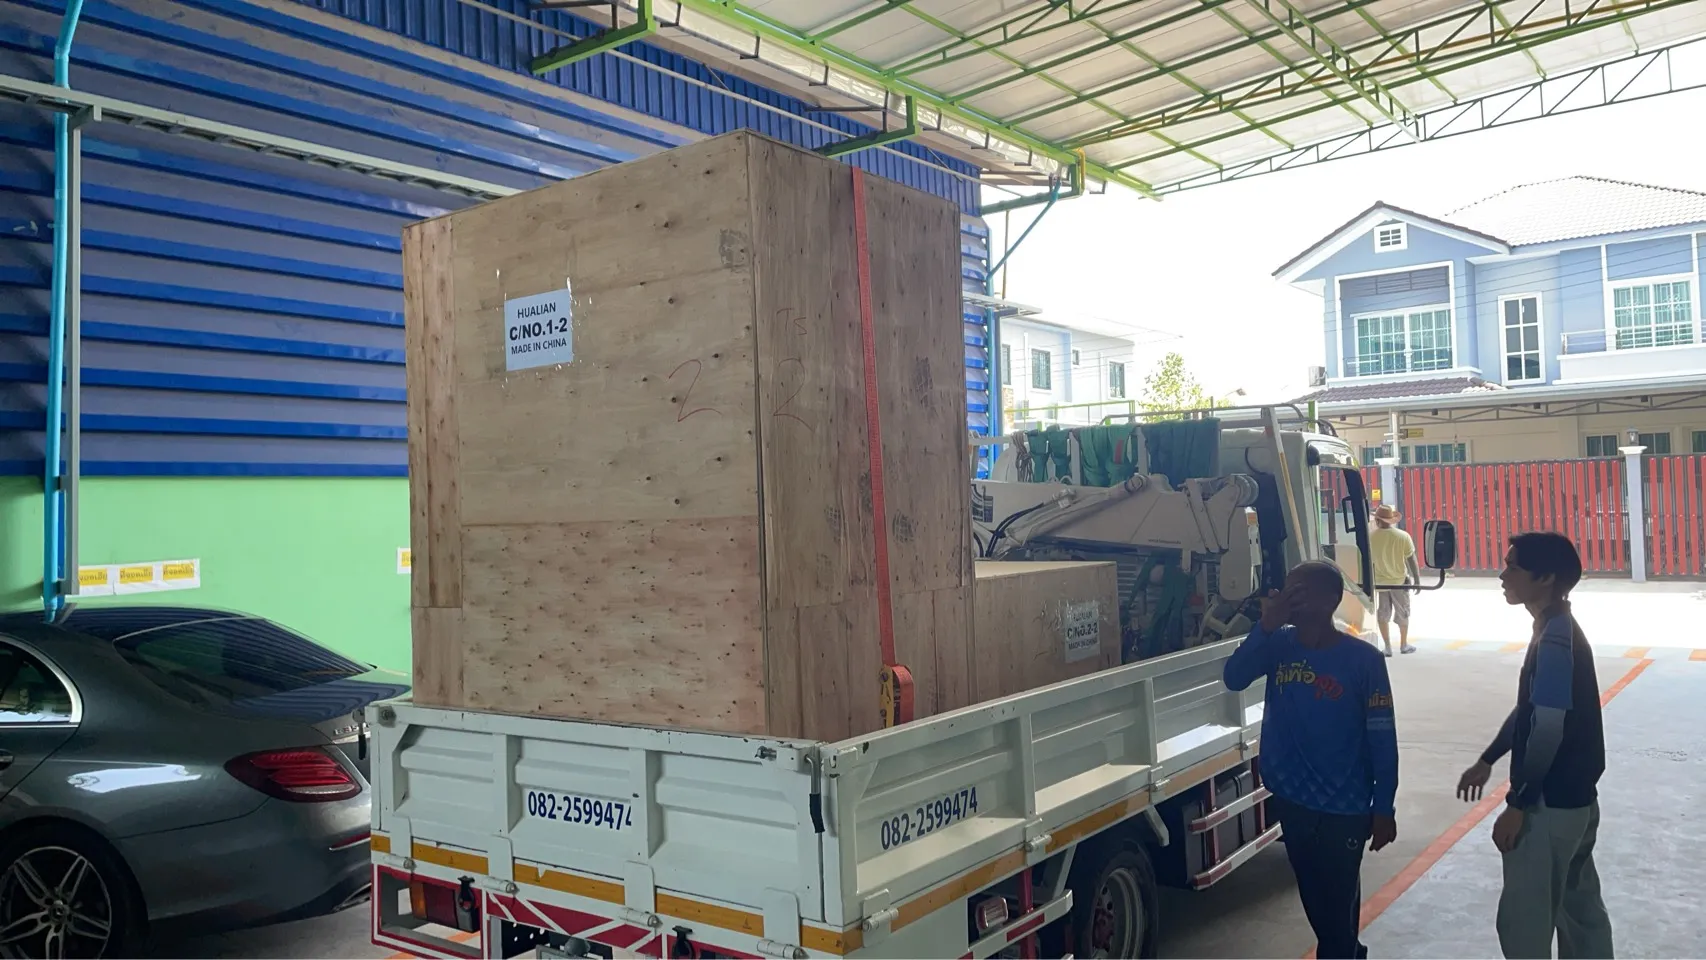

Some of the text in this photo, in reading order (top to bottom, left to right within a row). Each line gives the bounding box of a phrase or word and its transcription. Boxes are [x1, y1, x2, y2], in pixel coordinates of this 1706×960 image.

[509, 317, 568, 341] C/NO.1-2
[517, 302, 556, 319] HUALIAN
[511, 337, 567, 355] MADE IN CHINA
[669, 359, 722, 422] 2
[773, 358, 815, 433] 2
[881, 787, 978, 850] 082-2599474
